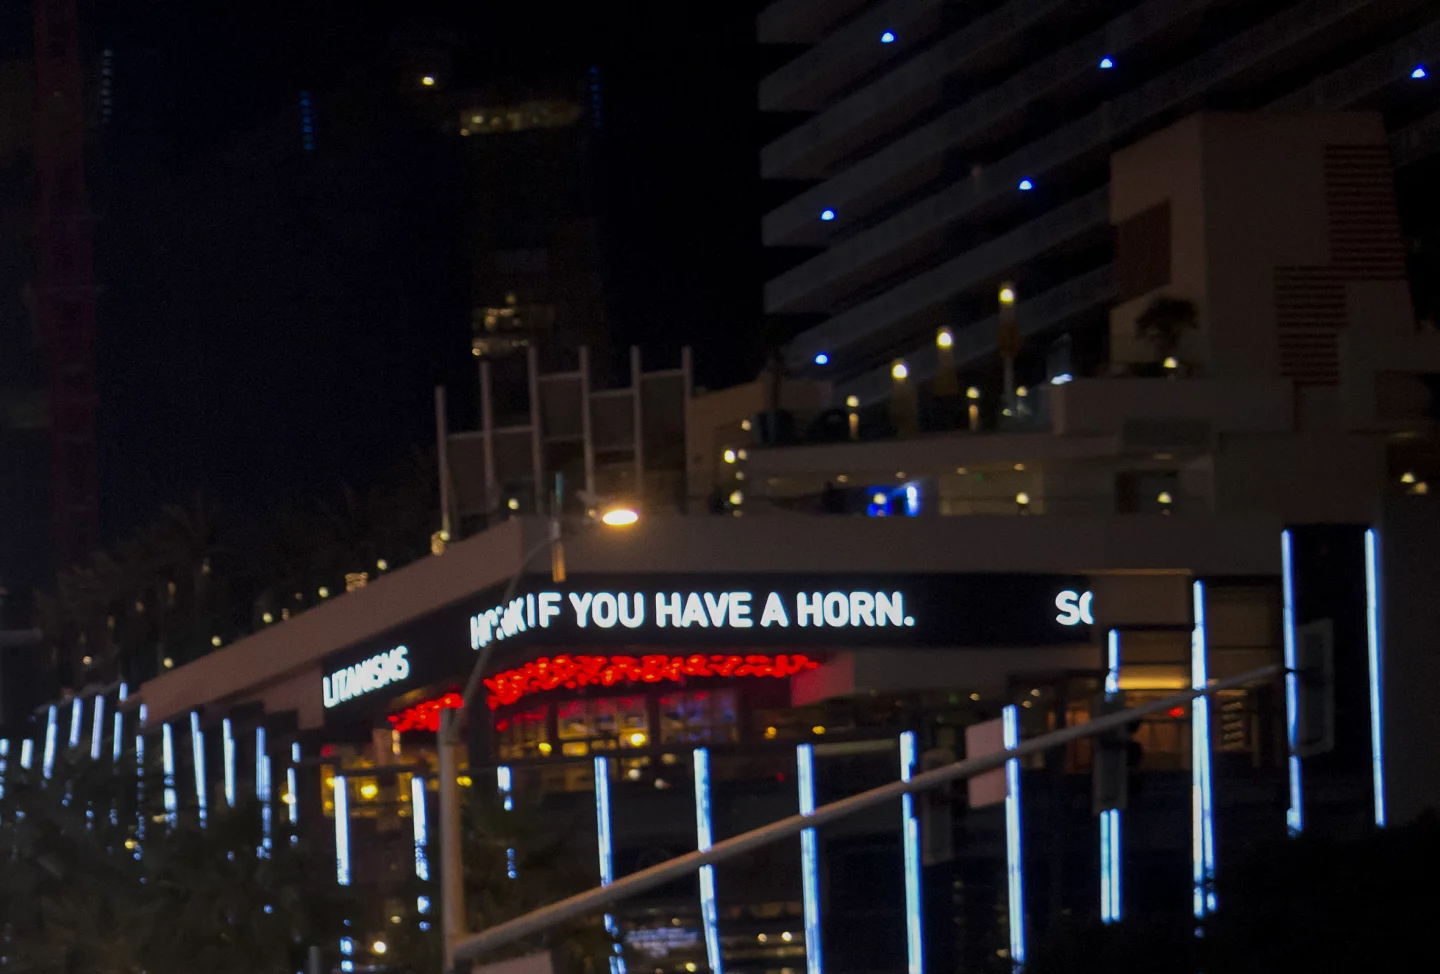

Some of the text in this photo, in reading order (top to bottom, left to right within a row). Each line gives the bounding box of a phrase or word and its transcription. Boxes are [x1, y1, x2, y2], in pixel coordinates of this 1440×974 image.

[527, 592, 561, 628] IF
[569, 592, 645, 629] YOU
[655, 592, 753, 628] HAVE
[760, 592, 789, 627] A
[796, 591, 915, 628] HORN.
